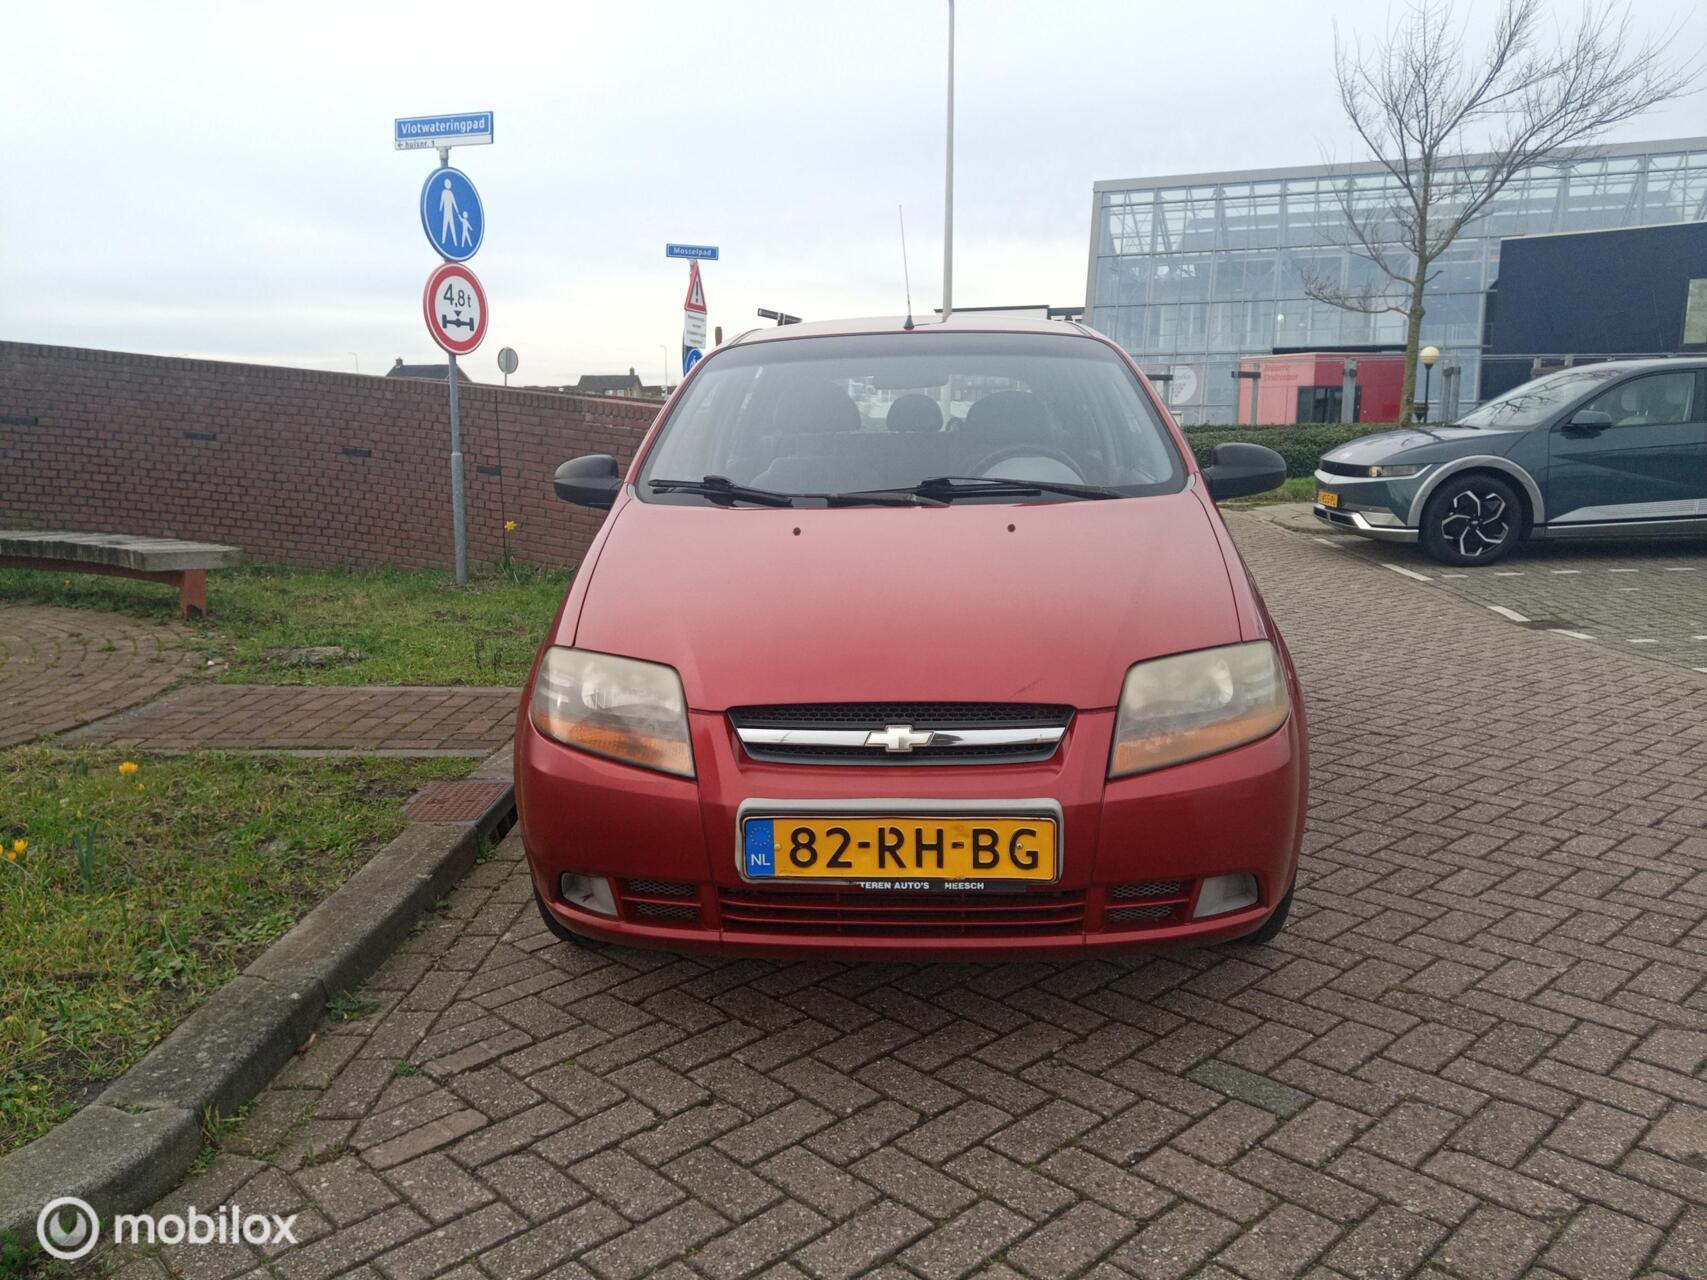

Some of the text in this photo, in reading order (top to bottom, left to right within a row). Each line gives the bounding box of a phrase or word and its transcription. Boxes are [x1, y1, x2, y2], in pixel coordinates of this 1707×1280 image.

[400, 117, 485, 134] Vlotwateringpad
[673, 247, 712, 256] Mosselpad
[789, 826, 1040, 870] 82-RH-BG
[750, 853, 771, 866] NL
[894, 881, 930, 889] AUTO'S
[944, 882, 985, 890] HEESCH
